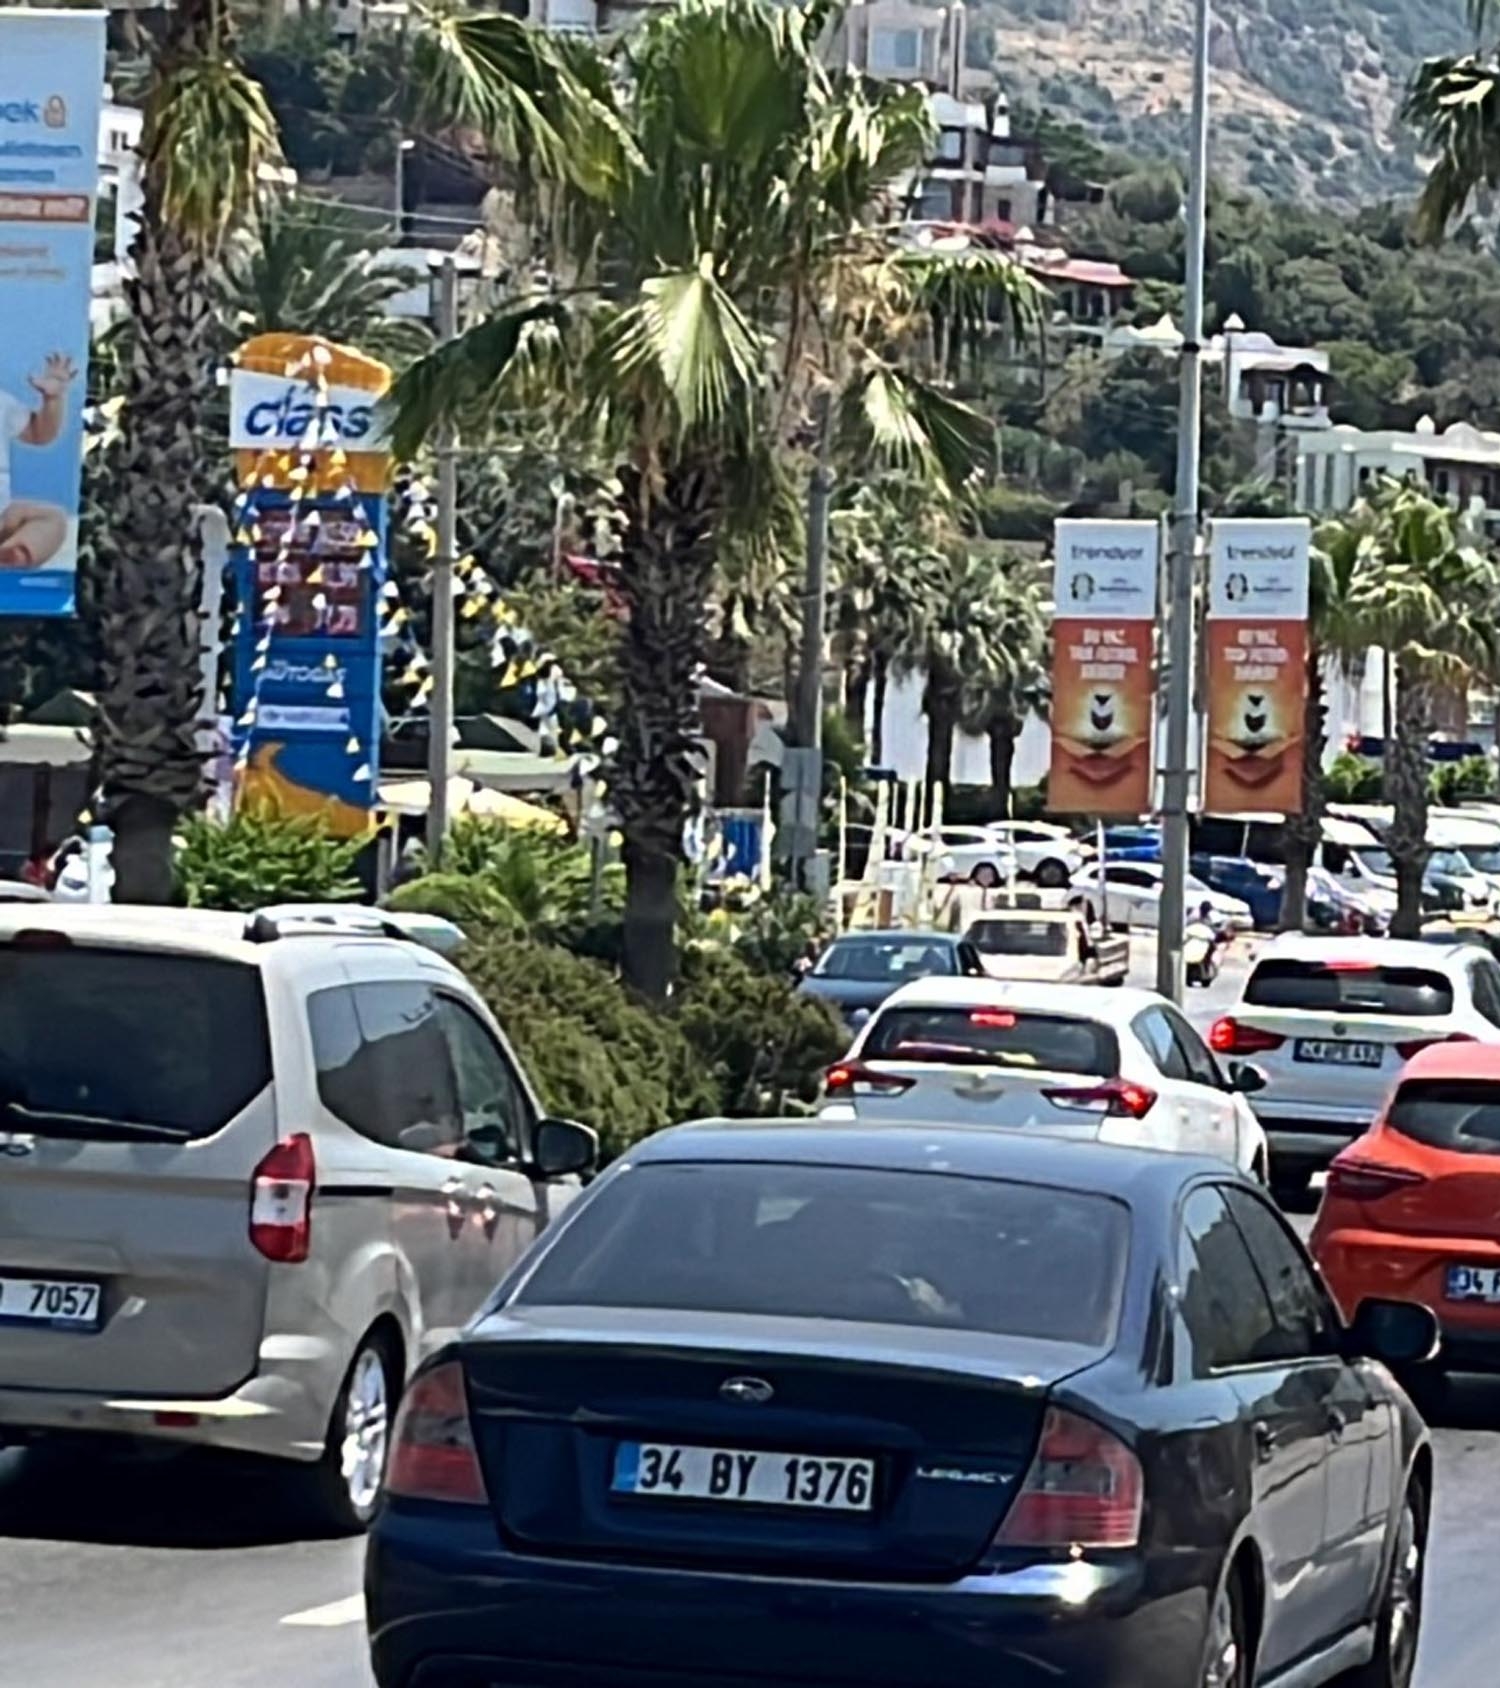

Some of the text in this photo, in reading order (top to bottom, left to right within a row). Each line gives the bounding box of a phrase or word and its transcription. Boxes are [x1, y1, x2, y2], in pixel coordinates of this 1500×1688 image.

[30, 1284, 96, 1315] 7057
[640, 1447, 870, 1505] 34 BY 1376
[916, 1466, 1015, 1484] LEGACY
